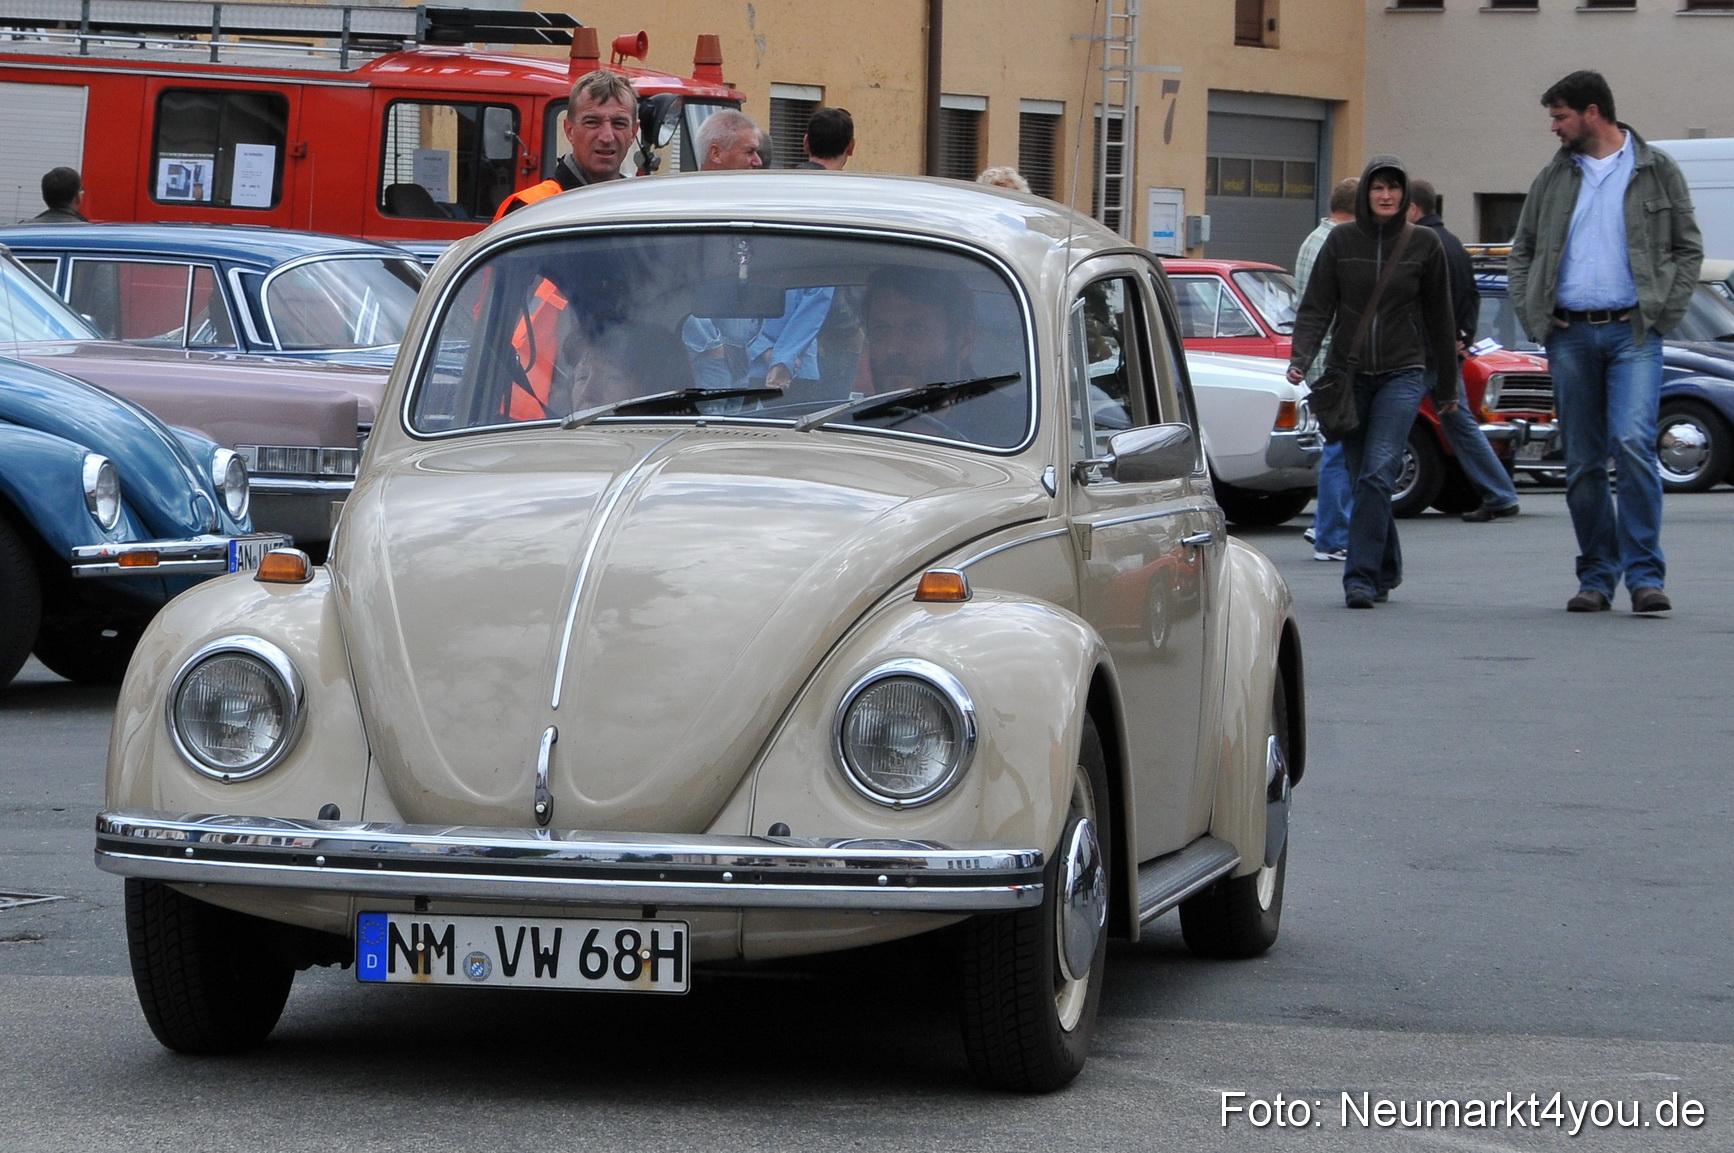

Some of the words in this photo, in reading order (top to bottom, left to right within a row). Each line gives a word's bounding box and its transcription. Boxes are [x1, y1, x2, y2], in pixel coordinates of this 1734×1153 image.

[1161, 79, 1181, 145] 7
[238, 544, 252, 571] AN
[366, 954, 378, 969] D
[387, 921, 455, 976] NM
[494, 925, 563, 979] VW
[578, 928, 684, 983] 68H
